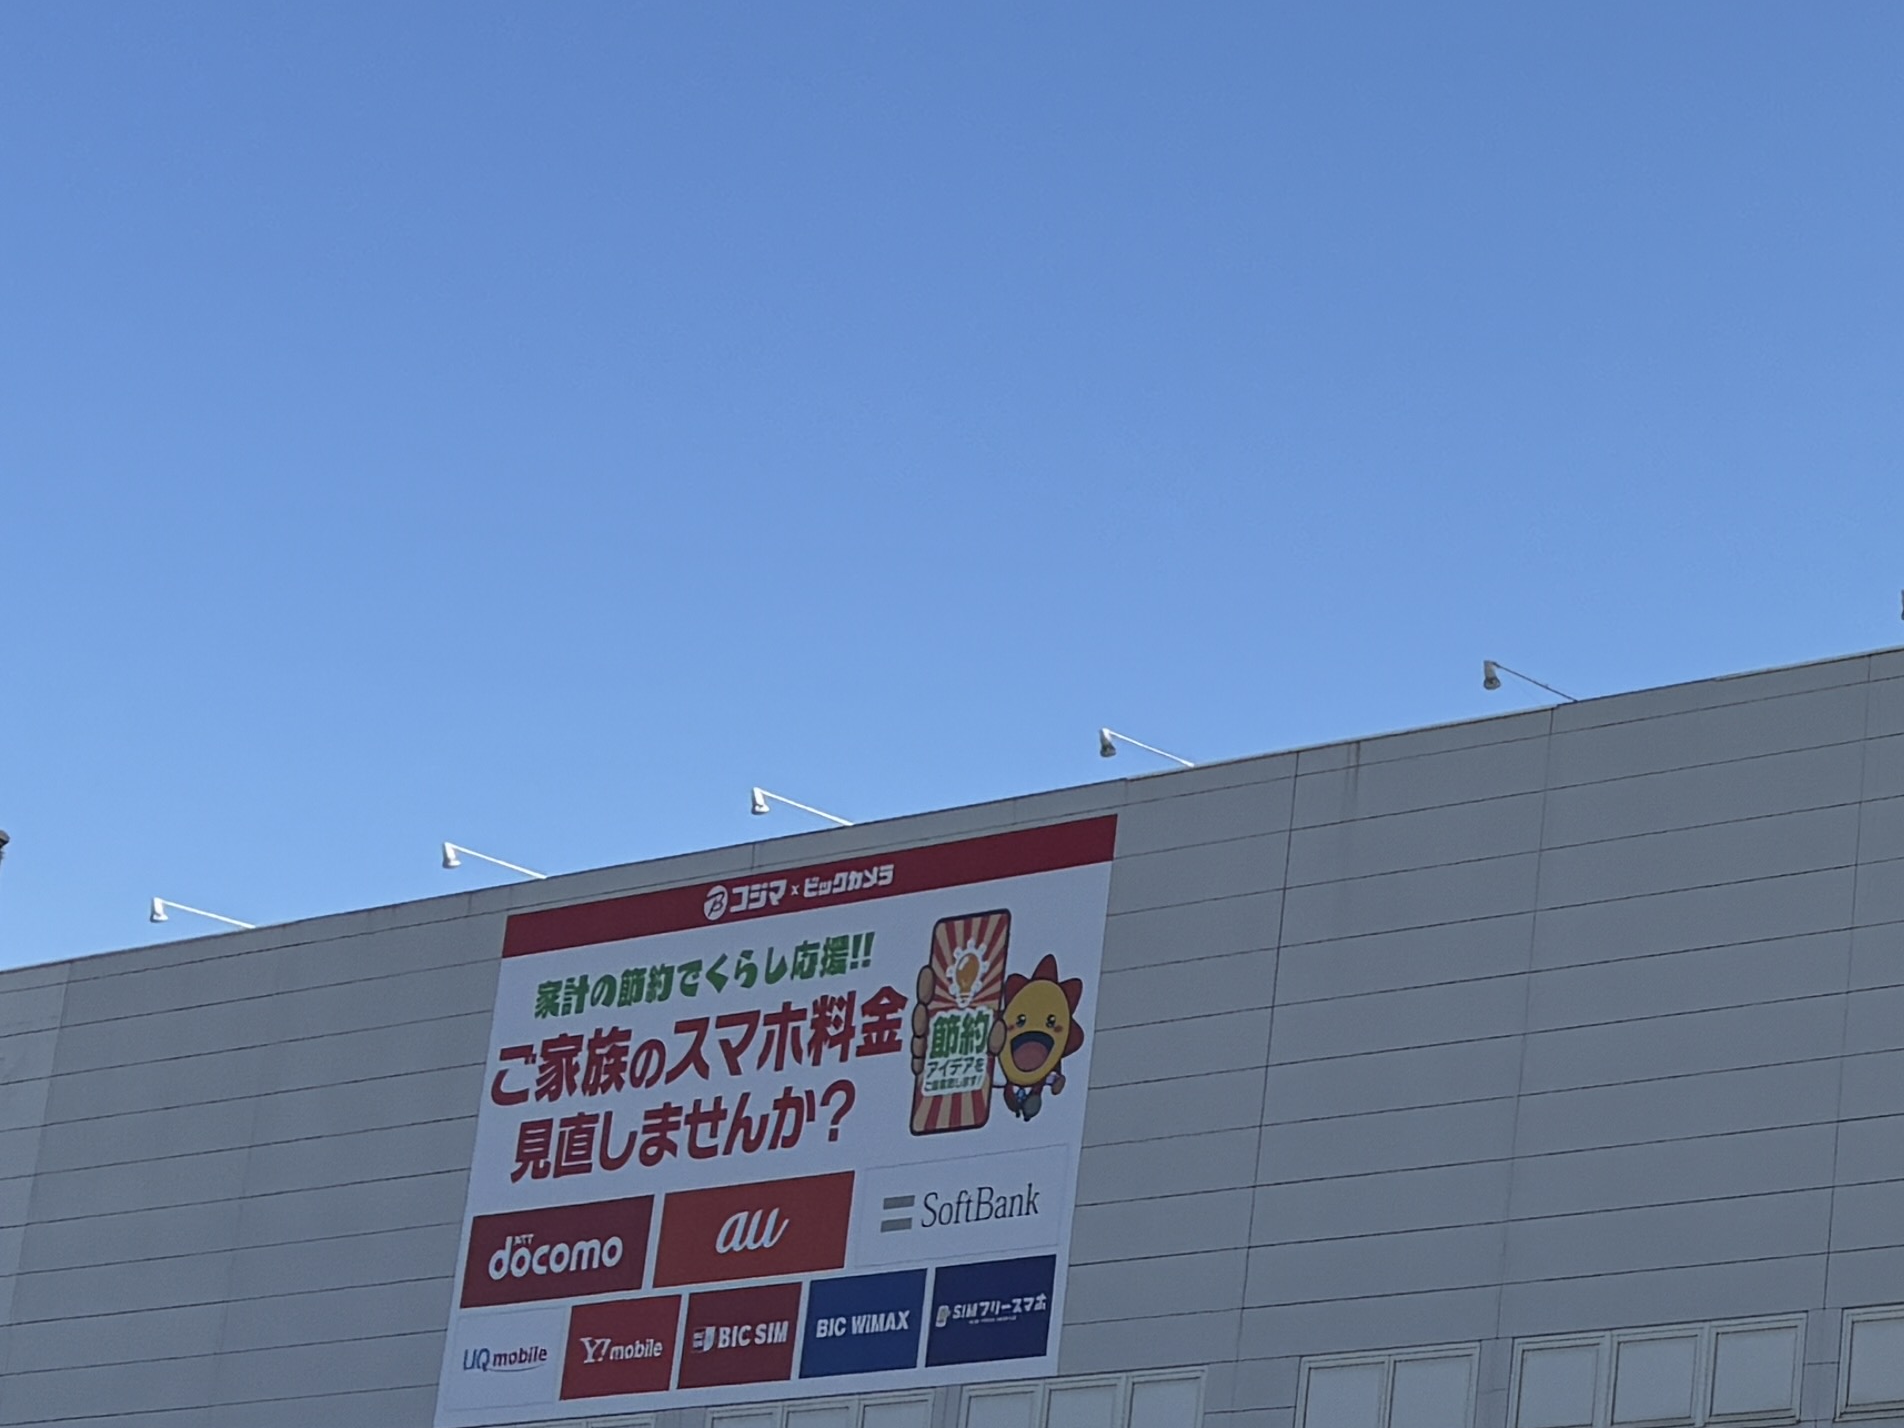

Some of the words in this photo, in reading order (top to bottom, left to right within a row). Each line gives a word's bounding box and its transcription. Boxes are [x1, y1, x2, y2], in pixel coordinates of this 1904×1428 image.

[534, 931, 876, 1020] 家計の節約でくらし応援!!
[489, 984, 909, 1108] ご家族のスマホ料金
[929, 1010, 991, 1059] 節約
[509, 1079, 857, 1184] 見直しませんか?
[920, 1182, 1041, 1229] SoftBank
[715, 1207, 790, 1254] au
[488, 1236, 623, 1280] docomo
[717, 1324, 752, 1349] BIC
[754, 1320, 790, 1346] SIM
[815, 1317, 847, 1339] BIC
